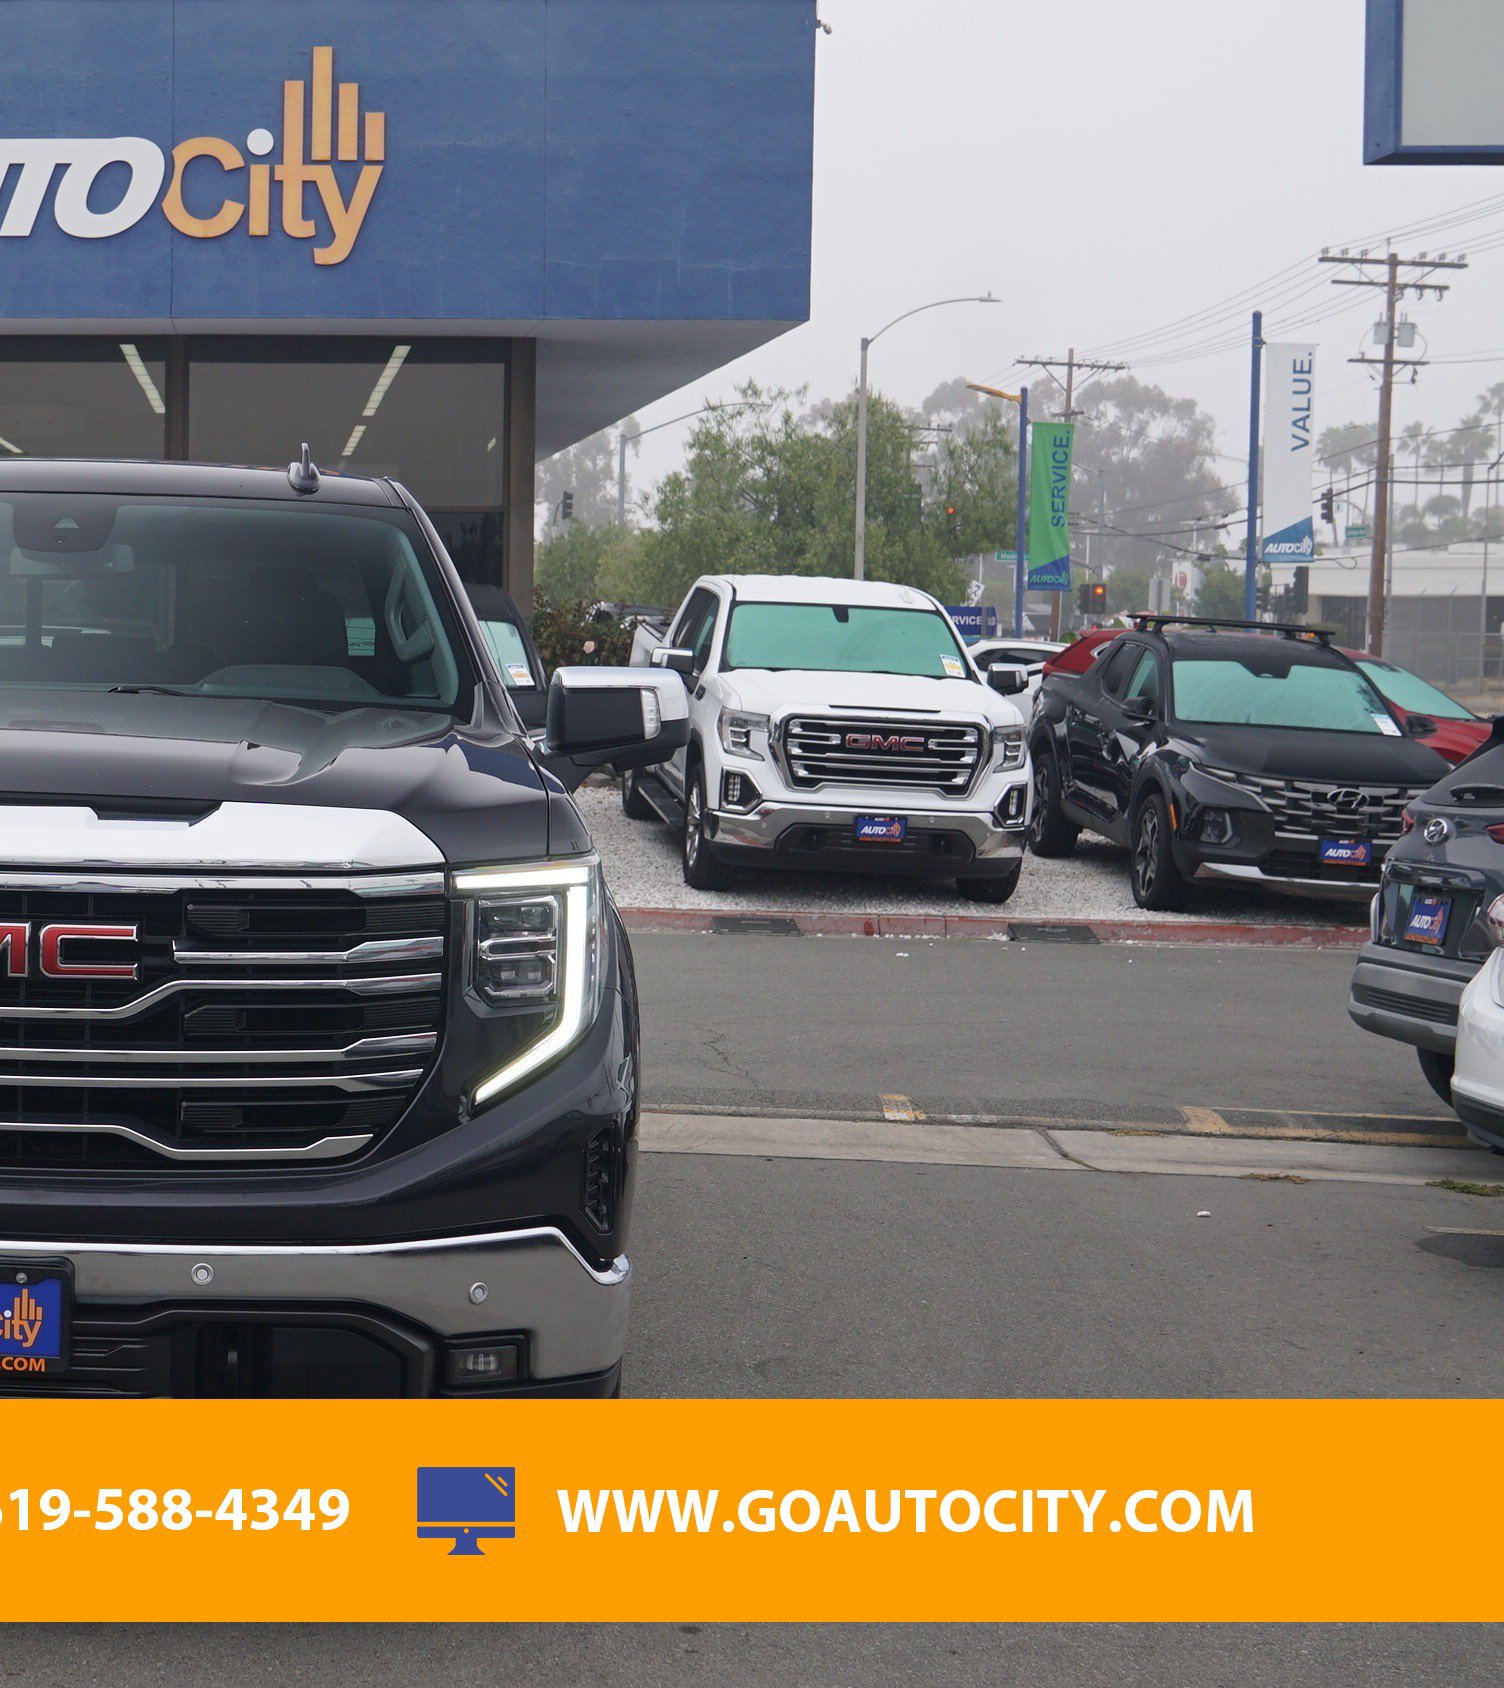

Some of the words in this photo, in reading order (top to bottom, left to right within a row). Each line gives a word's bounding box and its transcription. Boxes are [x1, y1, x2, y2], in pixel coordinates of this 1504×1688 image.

[1290, 351, 1313, 453] VALUE.
[1050, 430, 1071, 528] SERVICE.
[950, 615, 983, 626] RVICE
[845, 733, 925, 752] GMC
